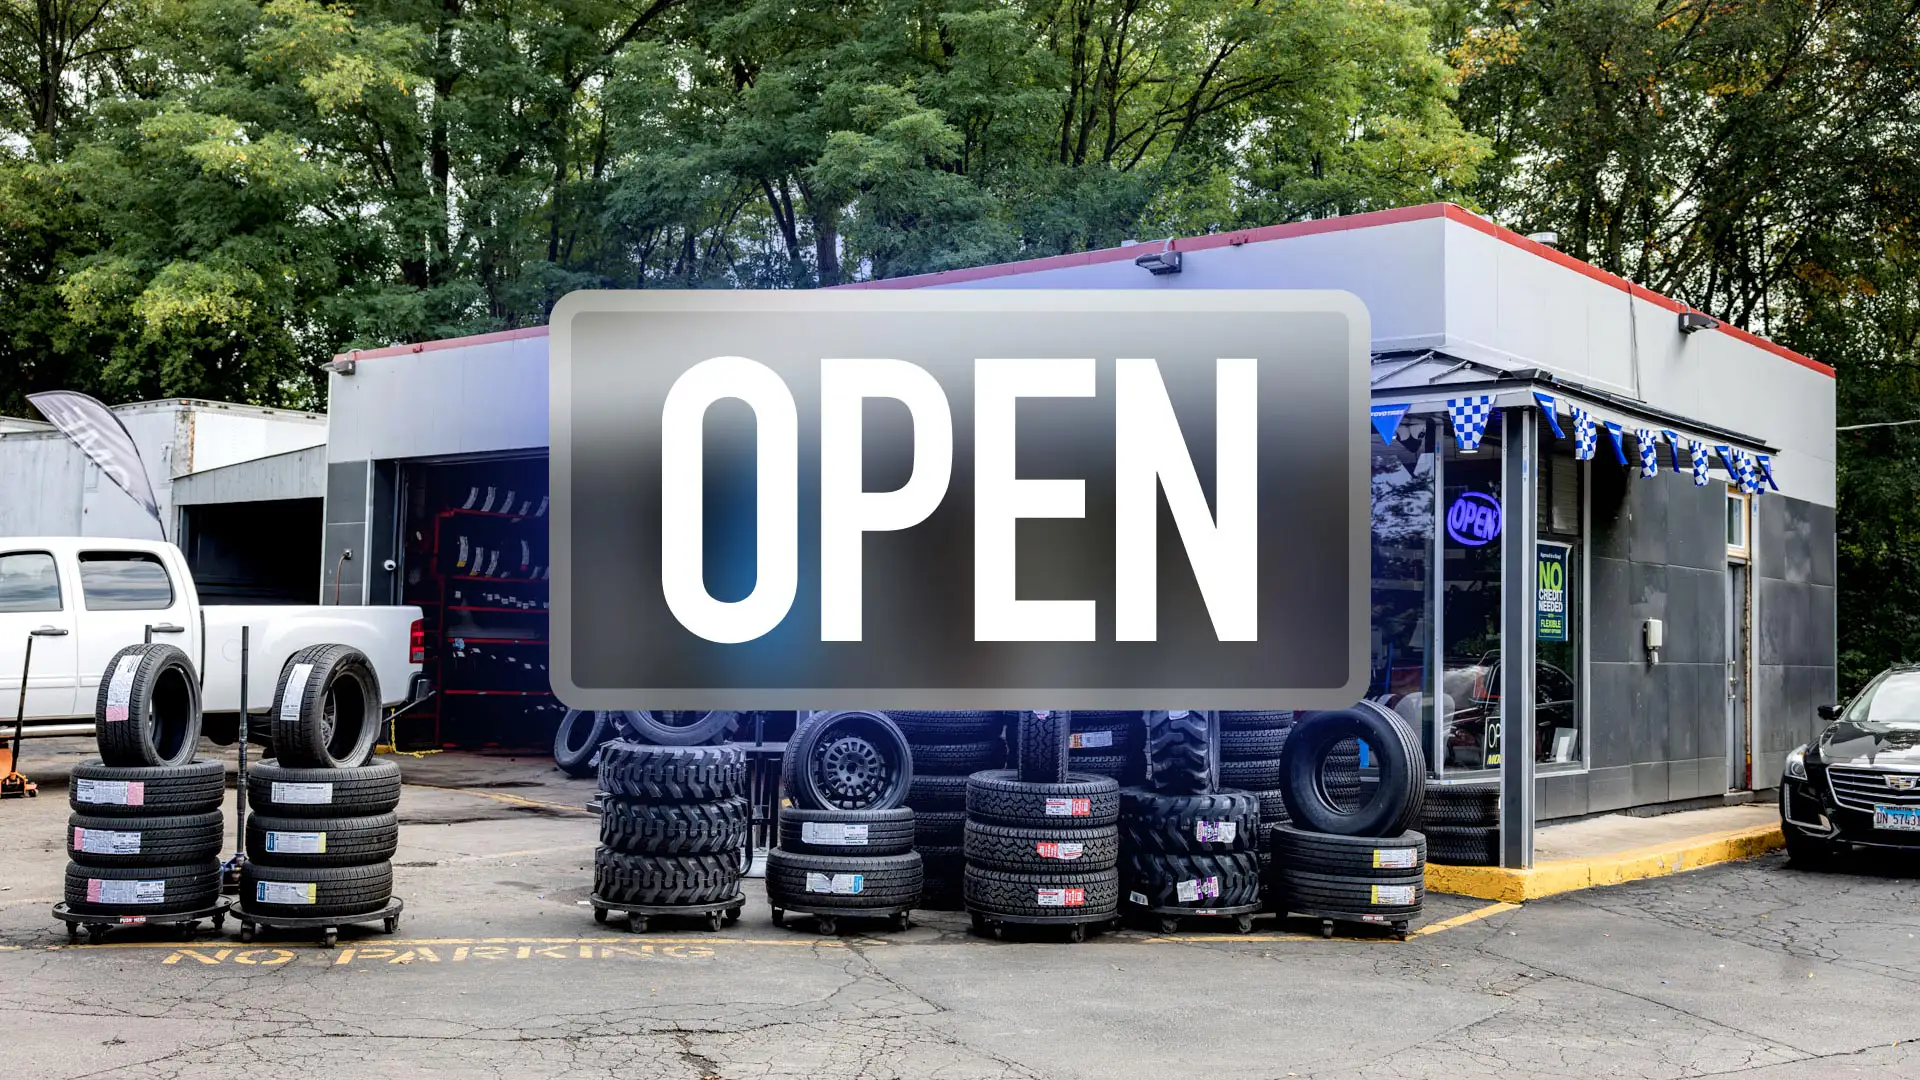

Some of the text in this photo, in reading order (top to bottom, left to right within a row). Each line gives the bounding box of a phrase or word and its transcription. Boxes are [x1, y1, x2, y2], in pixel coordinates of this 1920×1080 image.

[1451, 498, 1496, 541] OPEN
[1538, 561, 1563, 592] NO
[1538, 588, 1563, 602] CREDIT
[1538, 600, 1563, 613] NEEDED
[162, 945, 715, 964] NO PARKING
